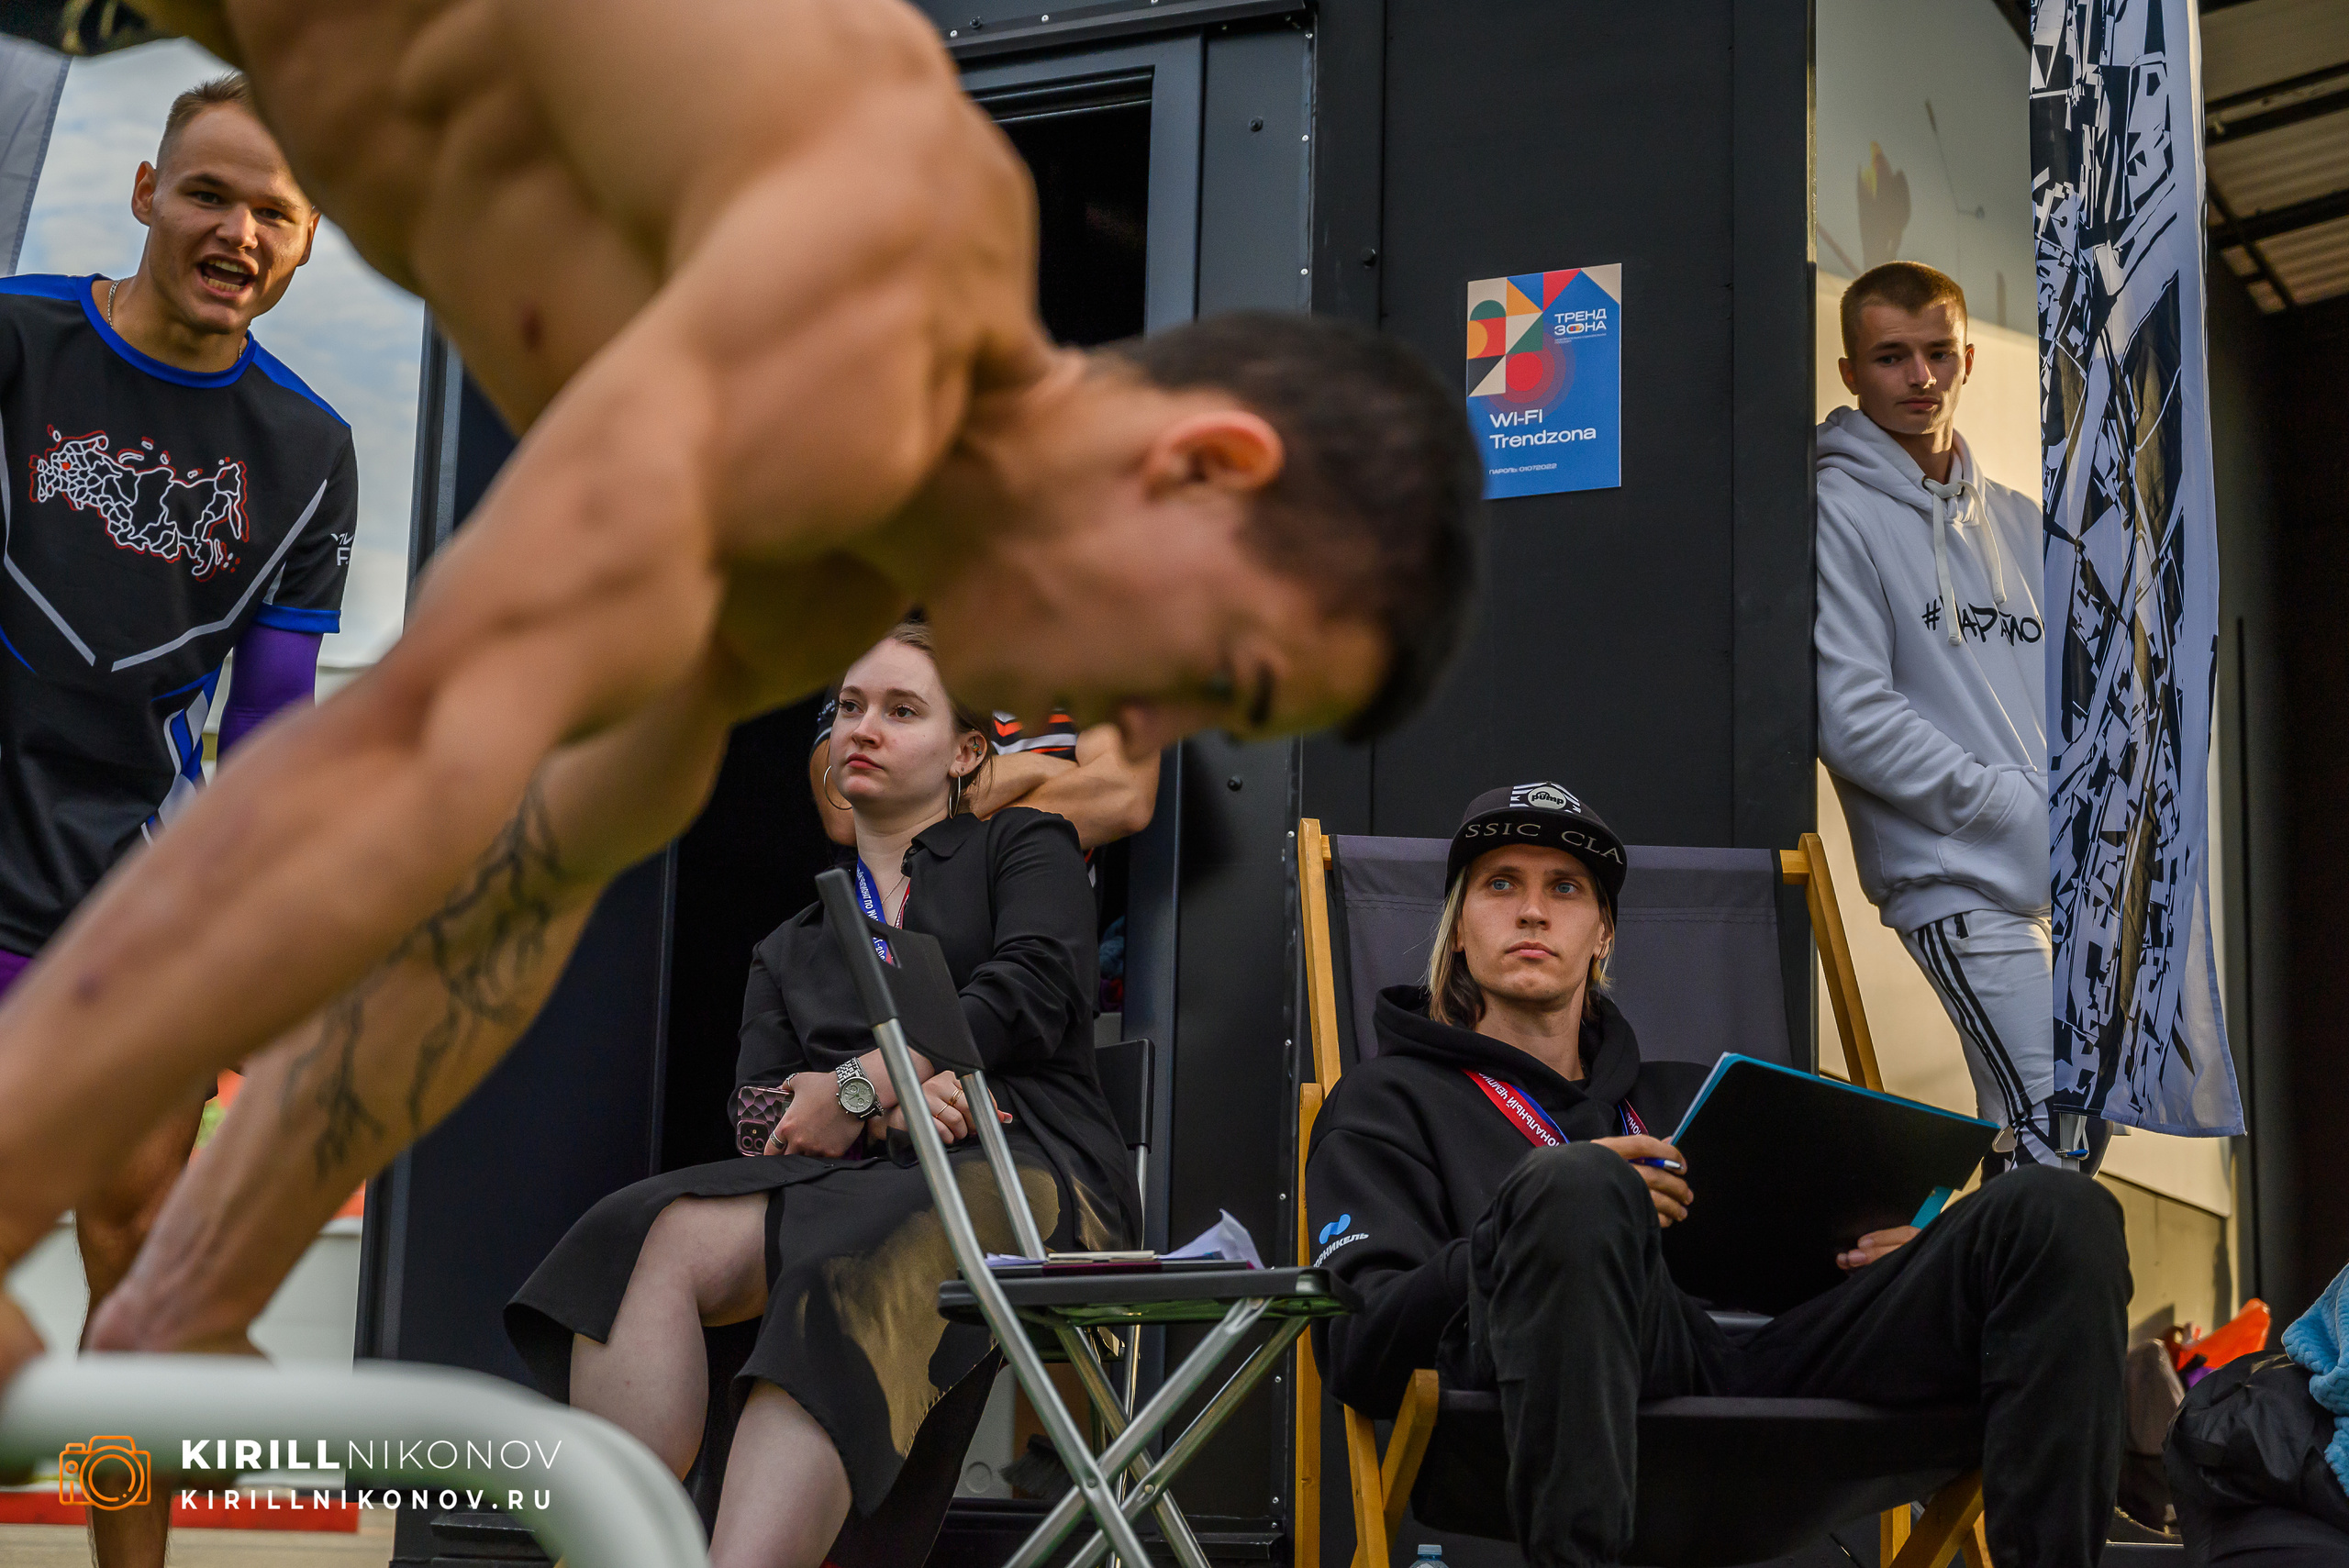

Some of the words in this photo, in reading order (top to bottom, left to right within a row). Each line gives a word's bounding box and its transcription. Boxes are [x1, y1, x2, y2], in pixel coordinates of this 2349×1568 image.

[1554, 308, 1607, 324] ТРЕНД
[1554, 320, 1607, 336] ЗОНА
[1489, 427, 1597, 450] Trendzona
[1531, 791, 1564, 806] pump
[1465, 822, 1542, 839] SSIC
[1561, 830, 1624, 865] CLA
[864, 899, 874, 909] ПО
[1313, 1233, 1369, 1268] ОРНИКЕЛЬ
